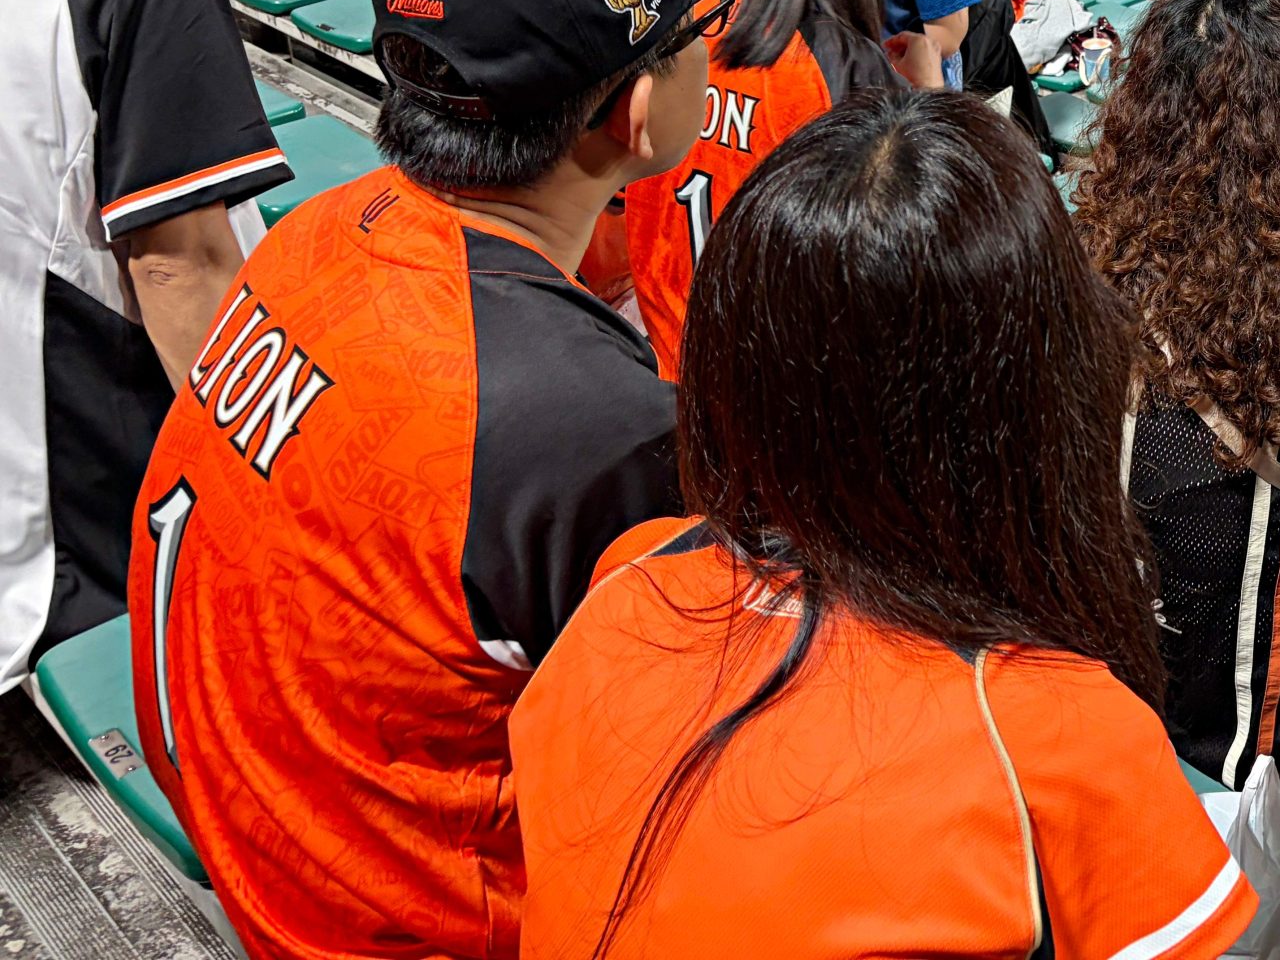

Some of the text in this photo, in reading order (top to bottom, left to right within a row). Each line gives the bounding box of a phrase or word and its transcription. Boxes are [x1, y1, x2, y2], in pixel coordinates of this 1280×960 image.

[700, 84, 761, 154] ON
[674, 168, 714, 285] 1
[189, 282, 337, 482] LION
[149, 473, 198, 780] 1
